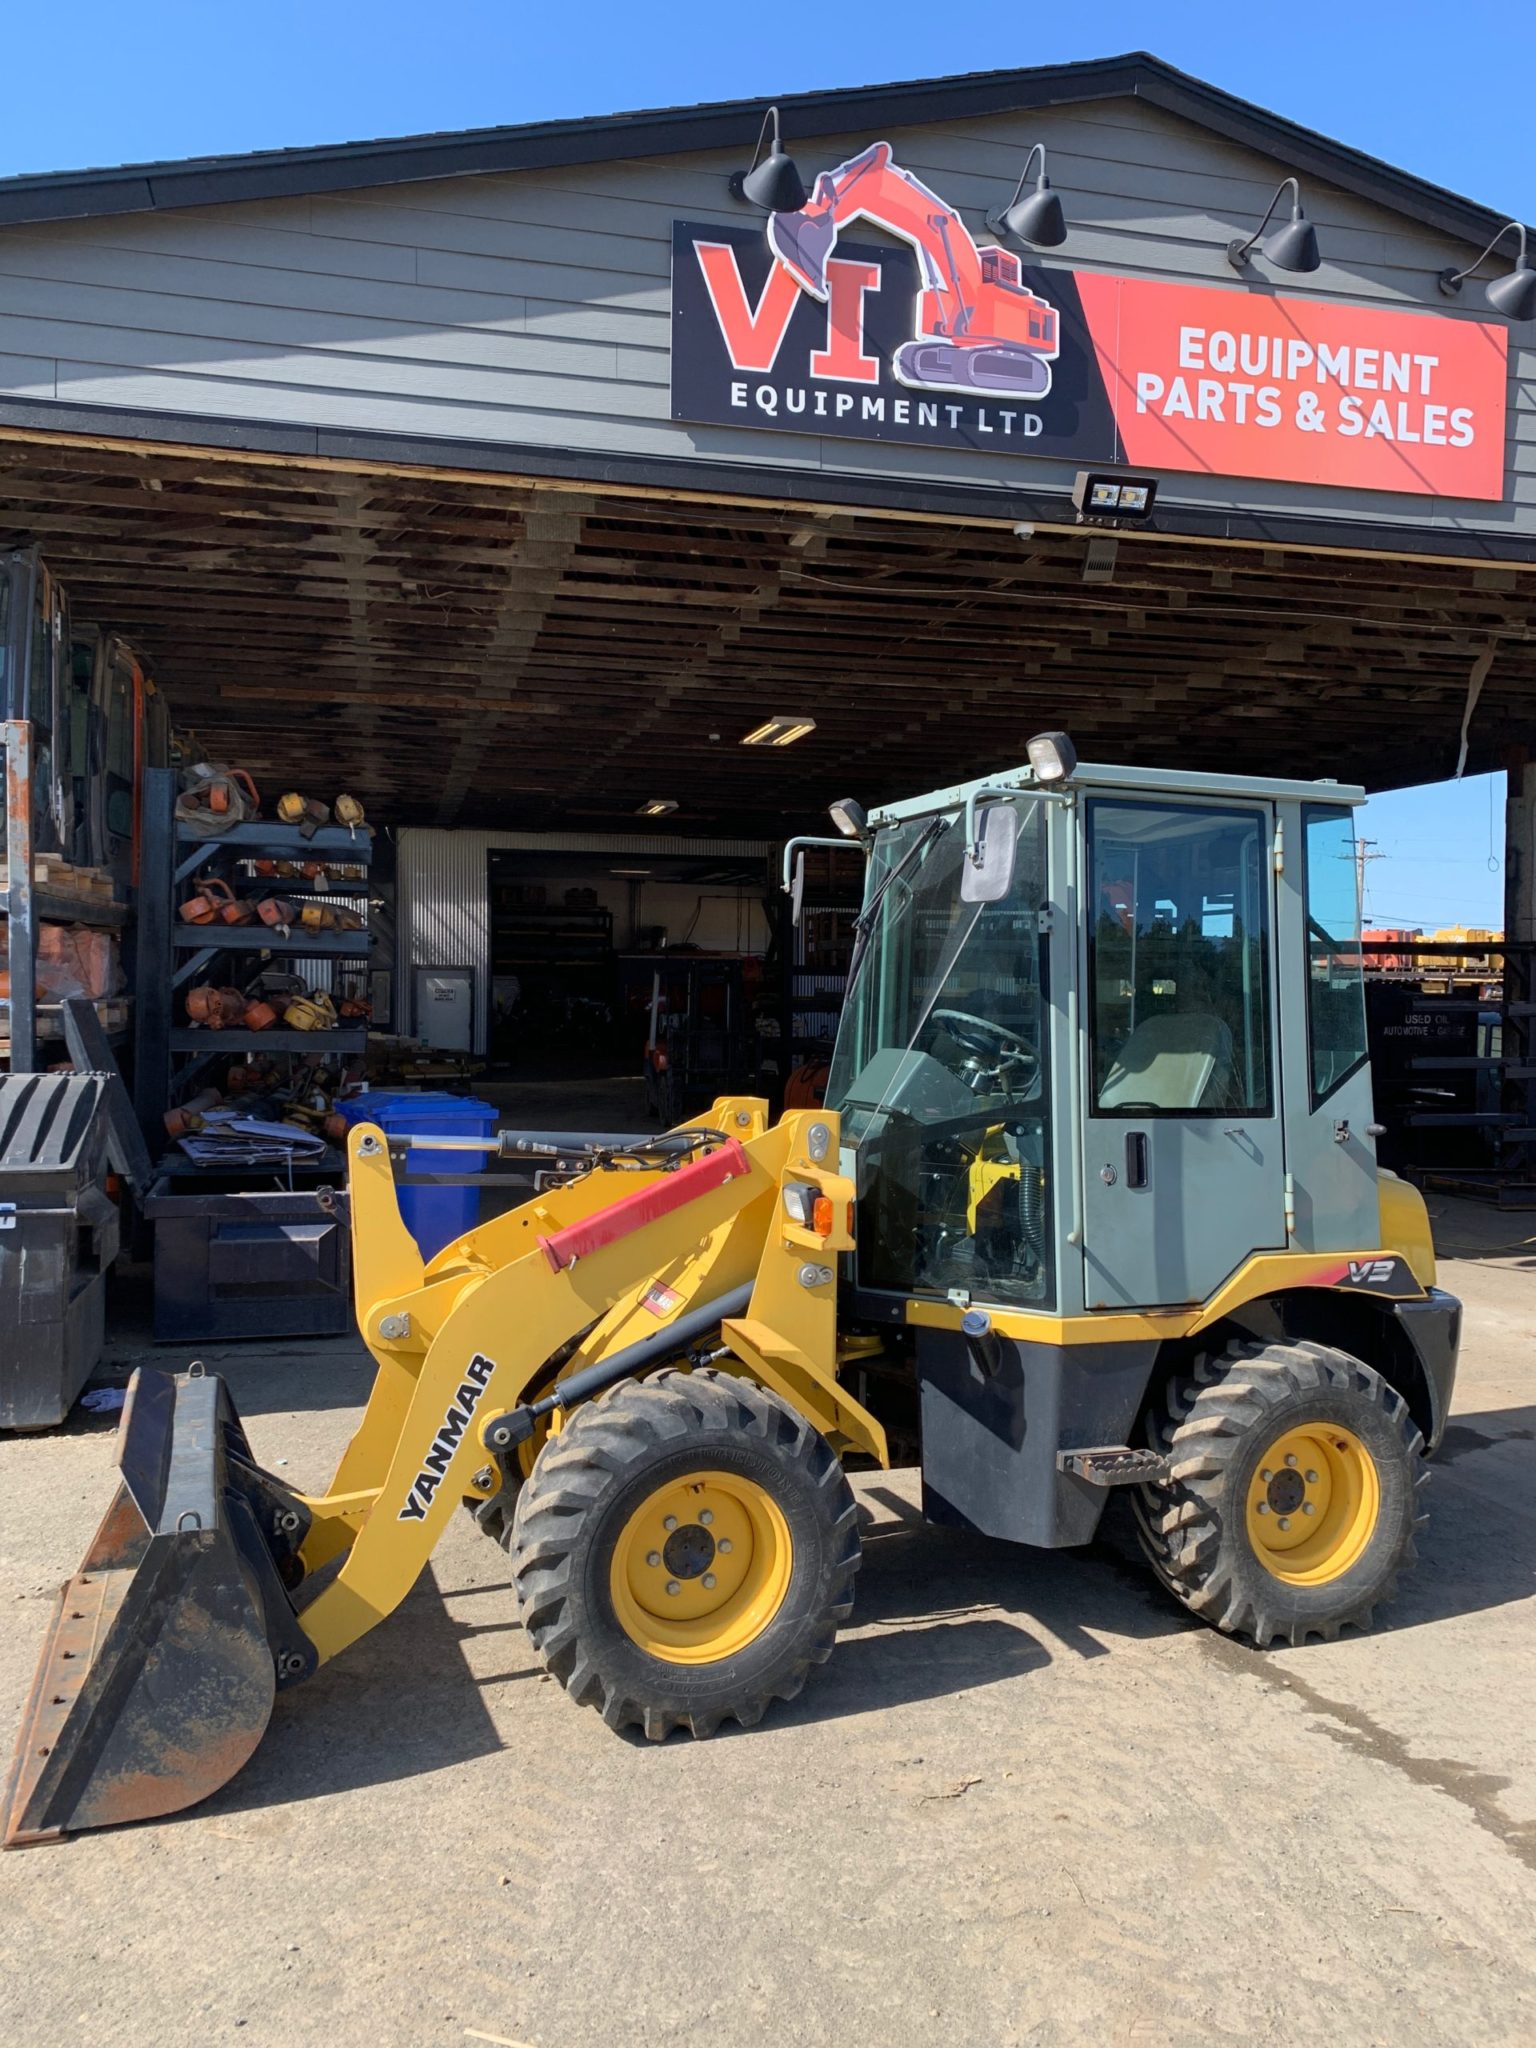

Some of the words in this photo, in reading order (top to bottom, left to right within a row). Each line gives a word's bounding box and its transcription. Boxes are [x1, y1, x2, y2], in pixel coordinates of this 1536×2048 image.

[692, 240, 882, 384] VI
[1179, 326, 1439, 395] EQUIPMENT
[730, 382, 963, 430] EQUIPMENT
[978, 408, 1044, 437] LTD
[1136, 372, 1282, 427] PARTS
[1295, 391, 1326, 432] &
[1337, 396, 1475, 447] SALES
[1383, 1026, 1429, 1036] AUTOMOTIVE
[1405, 1014, 1431, 1024] USED
[398, 1353, 496, 1521] YANMAR
